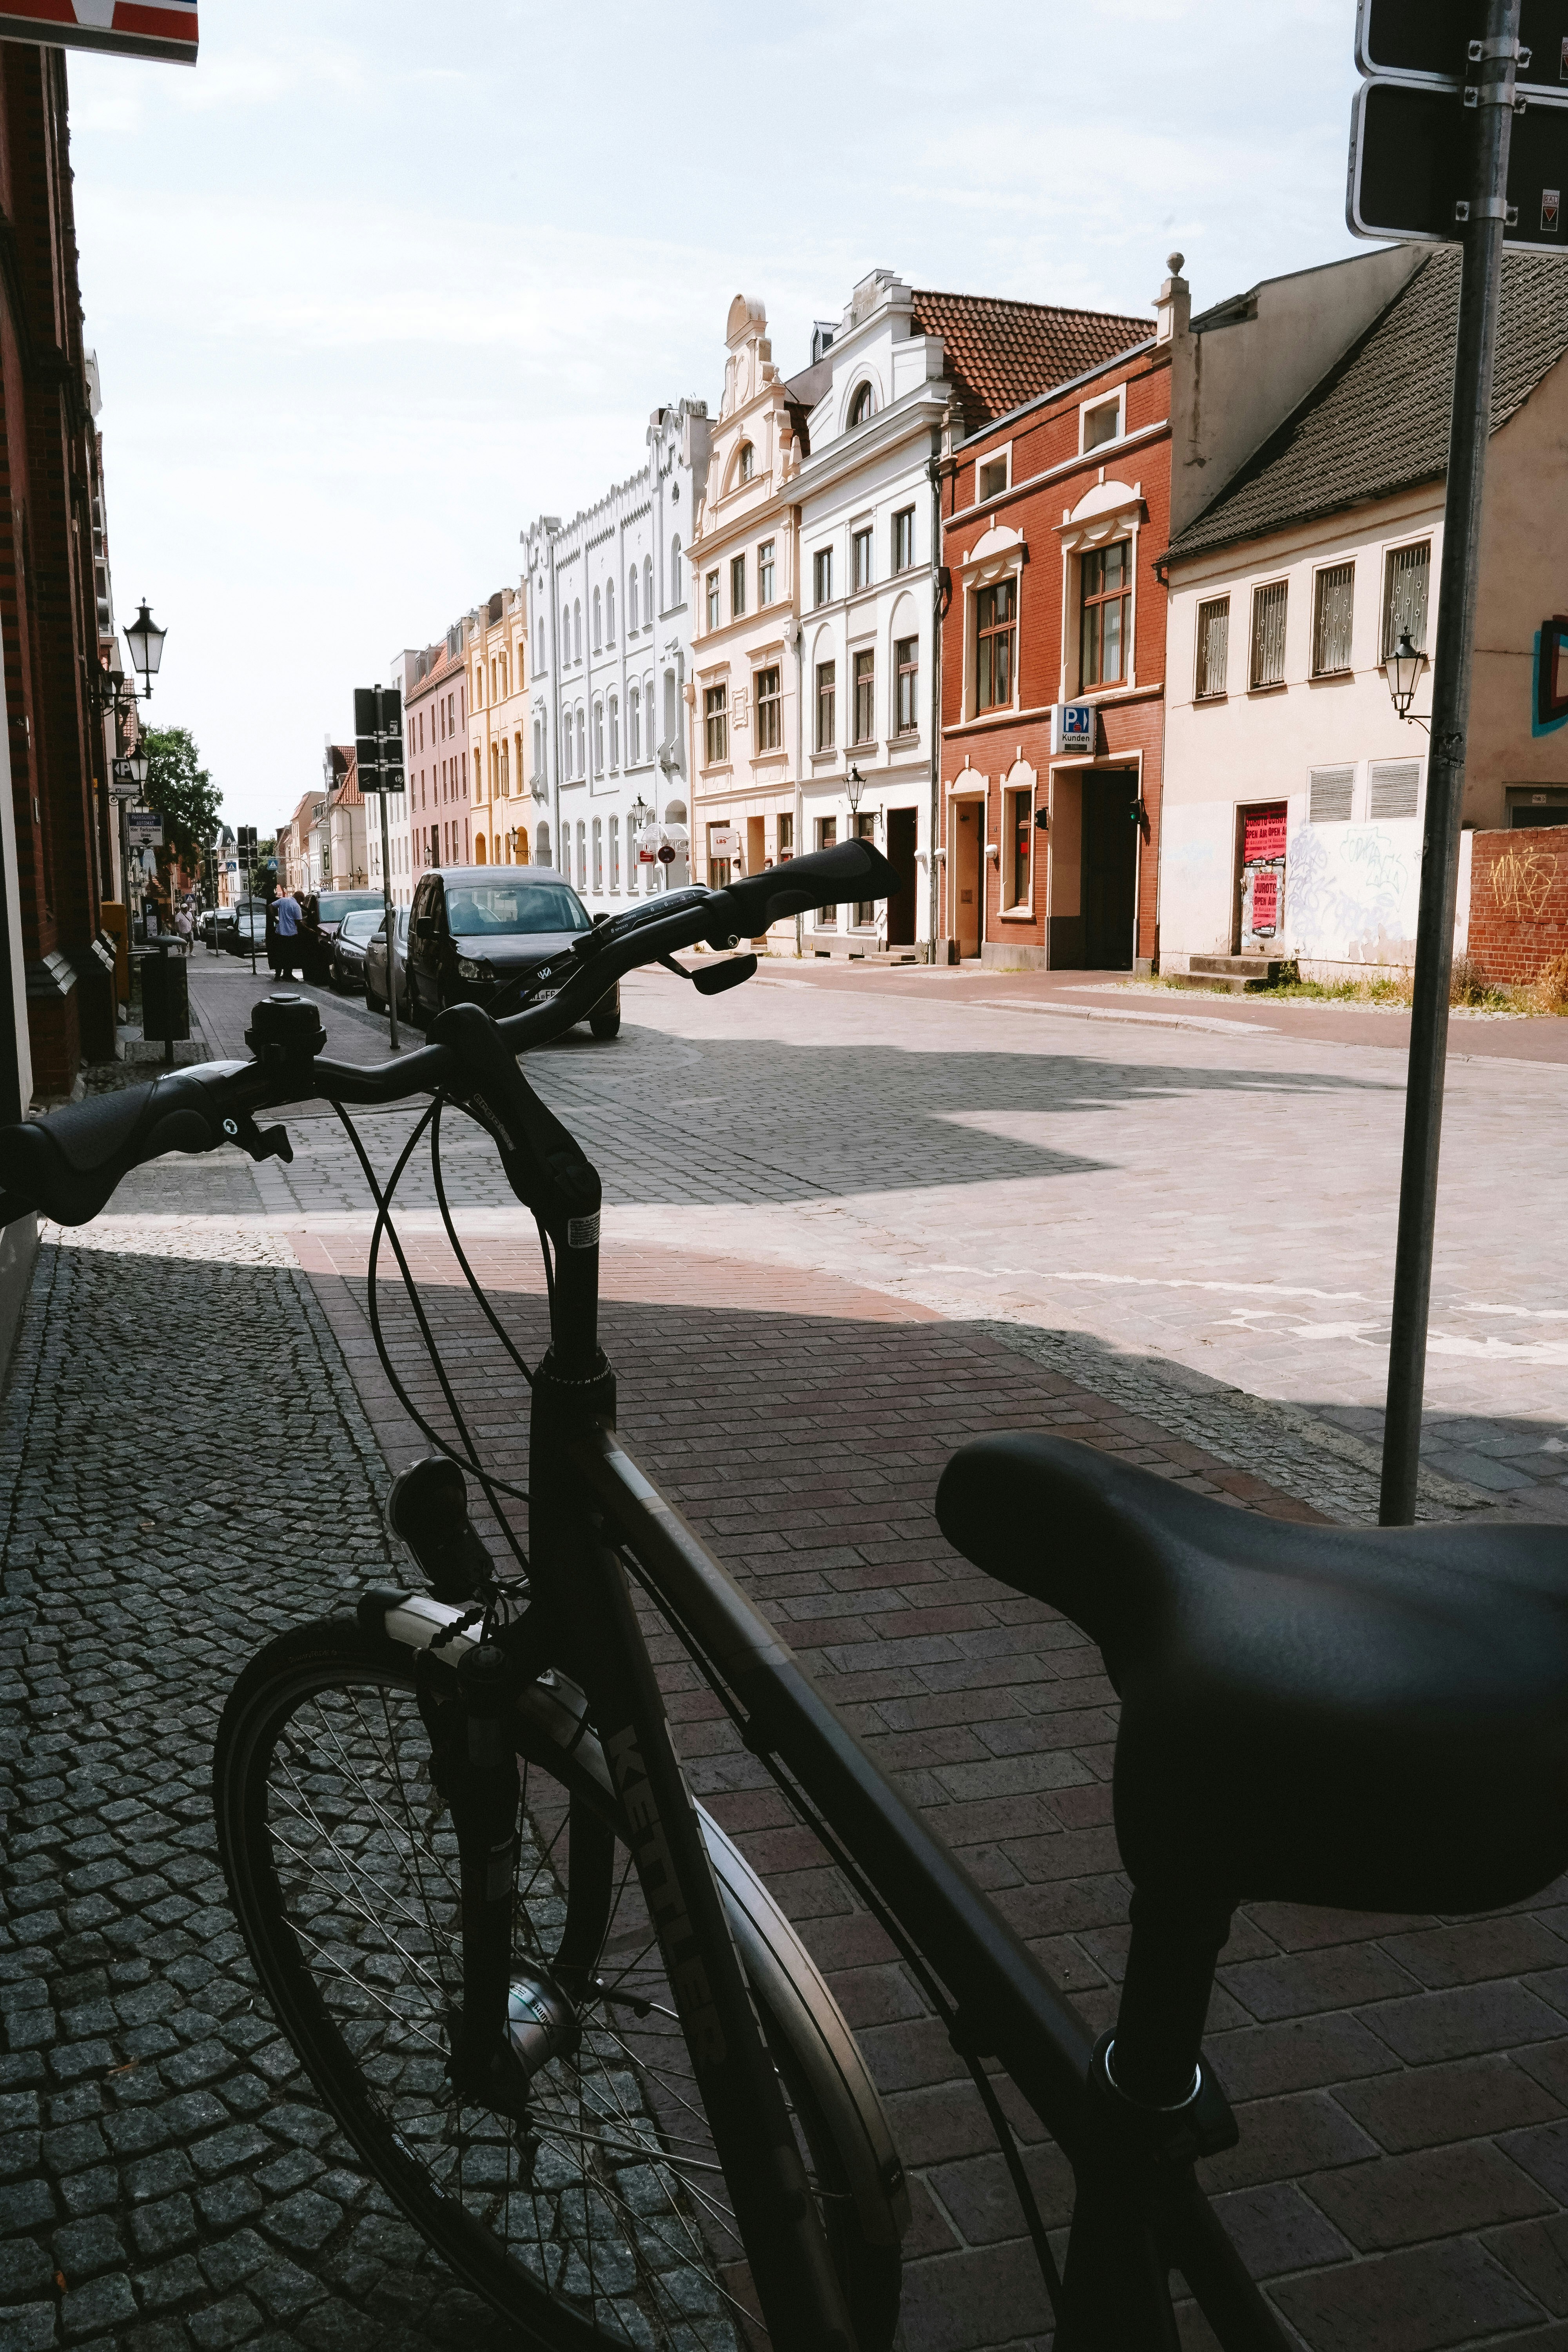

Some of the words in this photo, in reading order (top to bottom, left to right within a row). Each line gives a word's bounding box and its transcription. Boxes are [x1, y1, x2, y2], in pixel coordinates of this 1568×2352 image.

[1065, 708, 1078, 731] P
[1254, 896, 1266, 906] OPEN
[1268, 896, 1276, 906] AIR
[474, 1093, 514, 1151] ergotec
[608, 1724, 728, 2071] KETTLER
